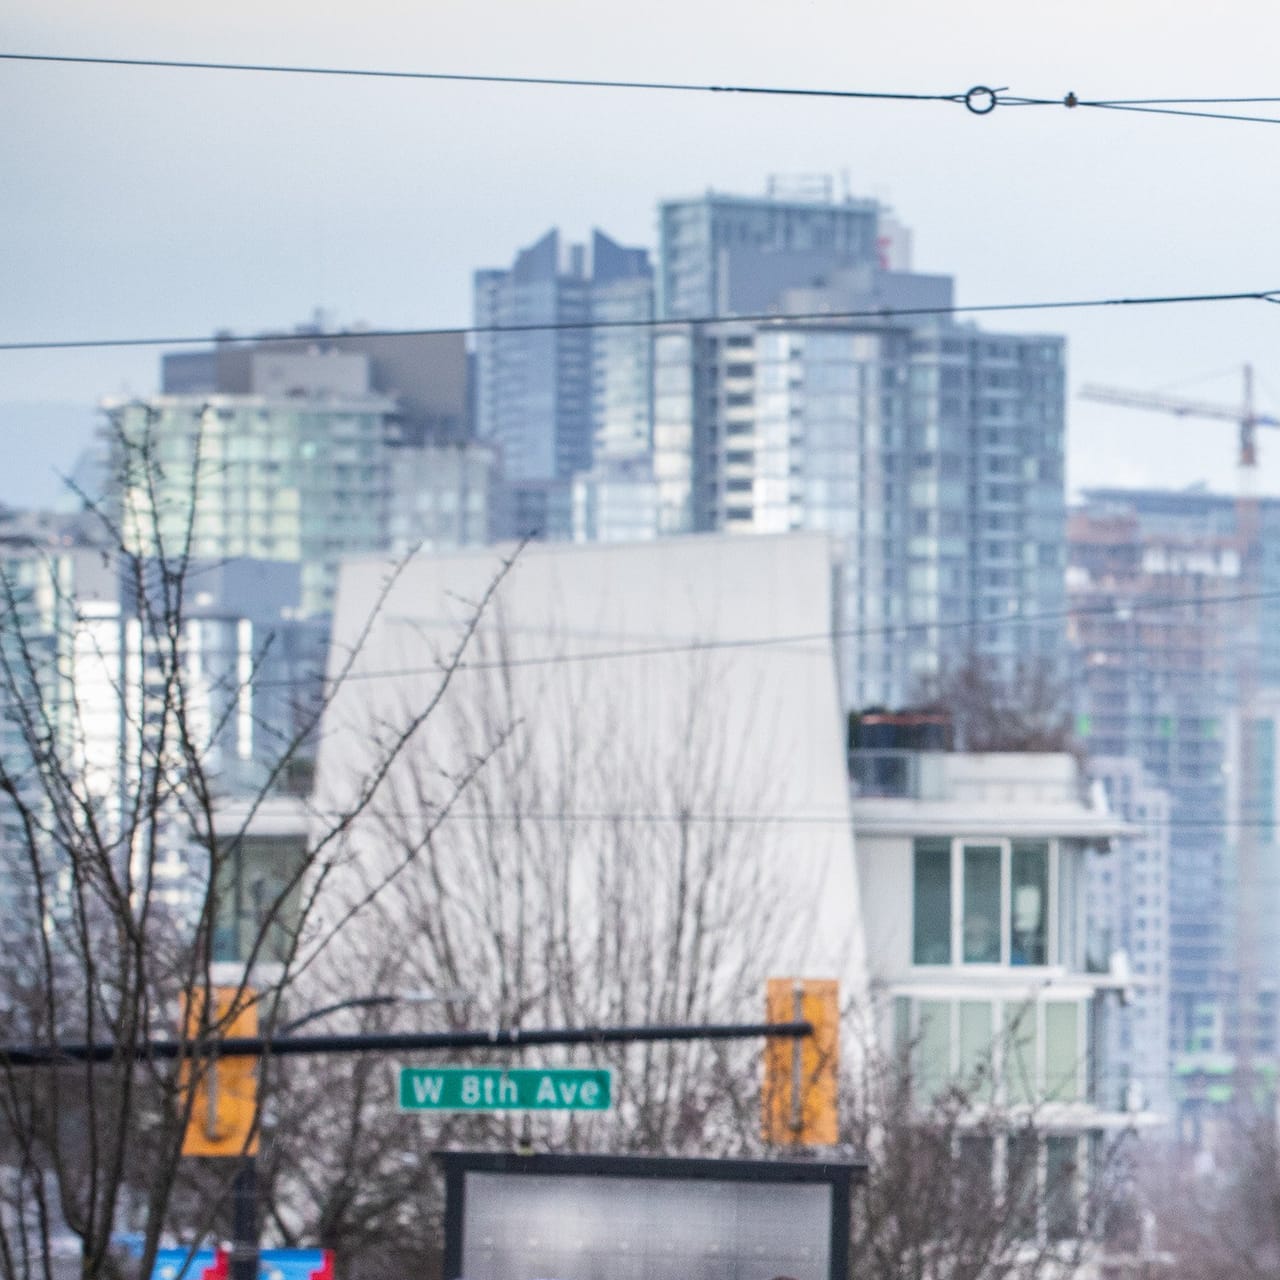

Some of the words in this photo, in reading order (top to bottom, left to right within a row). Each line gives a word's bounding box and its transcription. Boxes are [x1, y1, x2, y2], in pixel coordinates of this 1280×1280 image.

[412, 1075, 444, 1104] W
[460, 1075, 519, 1105] 8th
[536, 1076, 600, 1105] Ave
